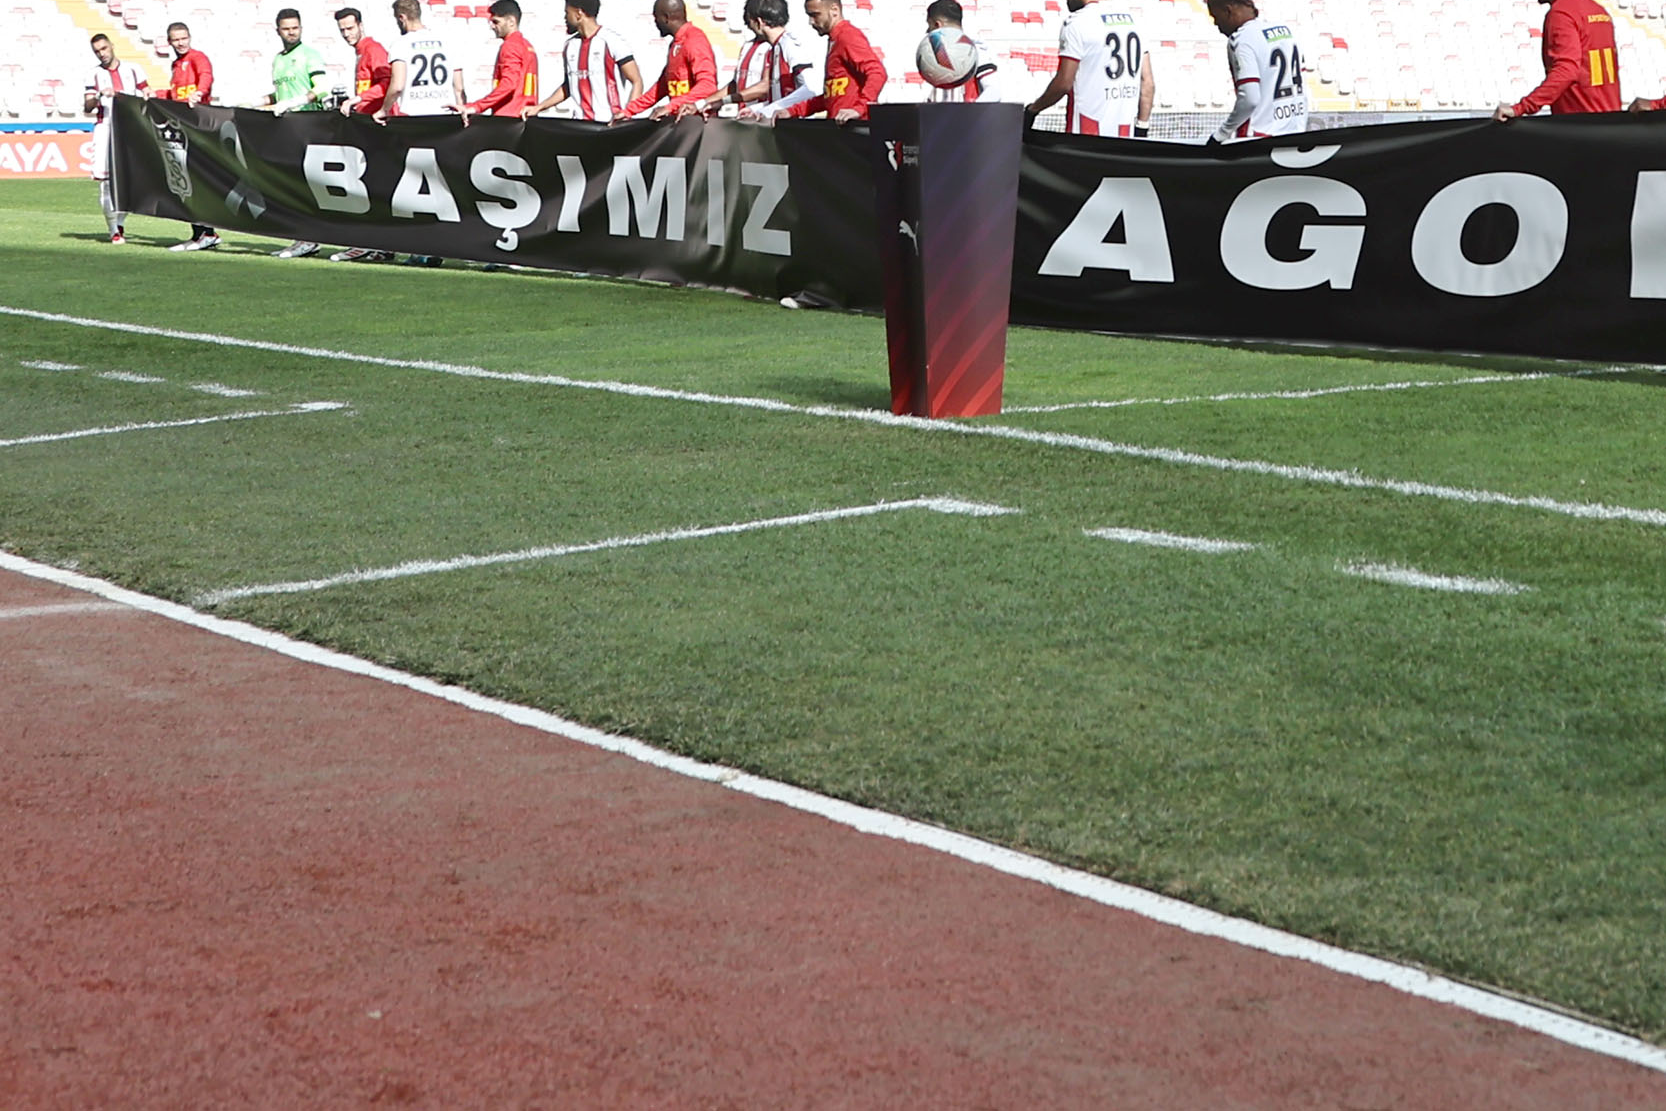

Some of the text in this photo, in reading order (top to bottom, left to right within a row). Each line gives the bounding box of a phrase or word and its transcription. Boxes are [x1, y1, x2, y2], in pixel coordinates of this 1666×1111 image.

[411, 53, 447, 87] 26
[1105, 31, 1141, 80] 30
[1269, 44, 1304, 100] 24
[304, 144, 791, 256] BAŞIMIZ
